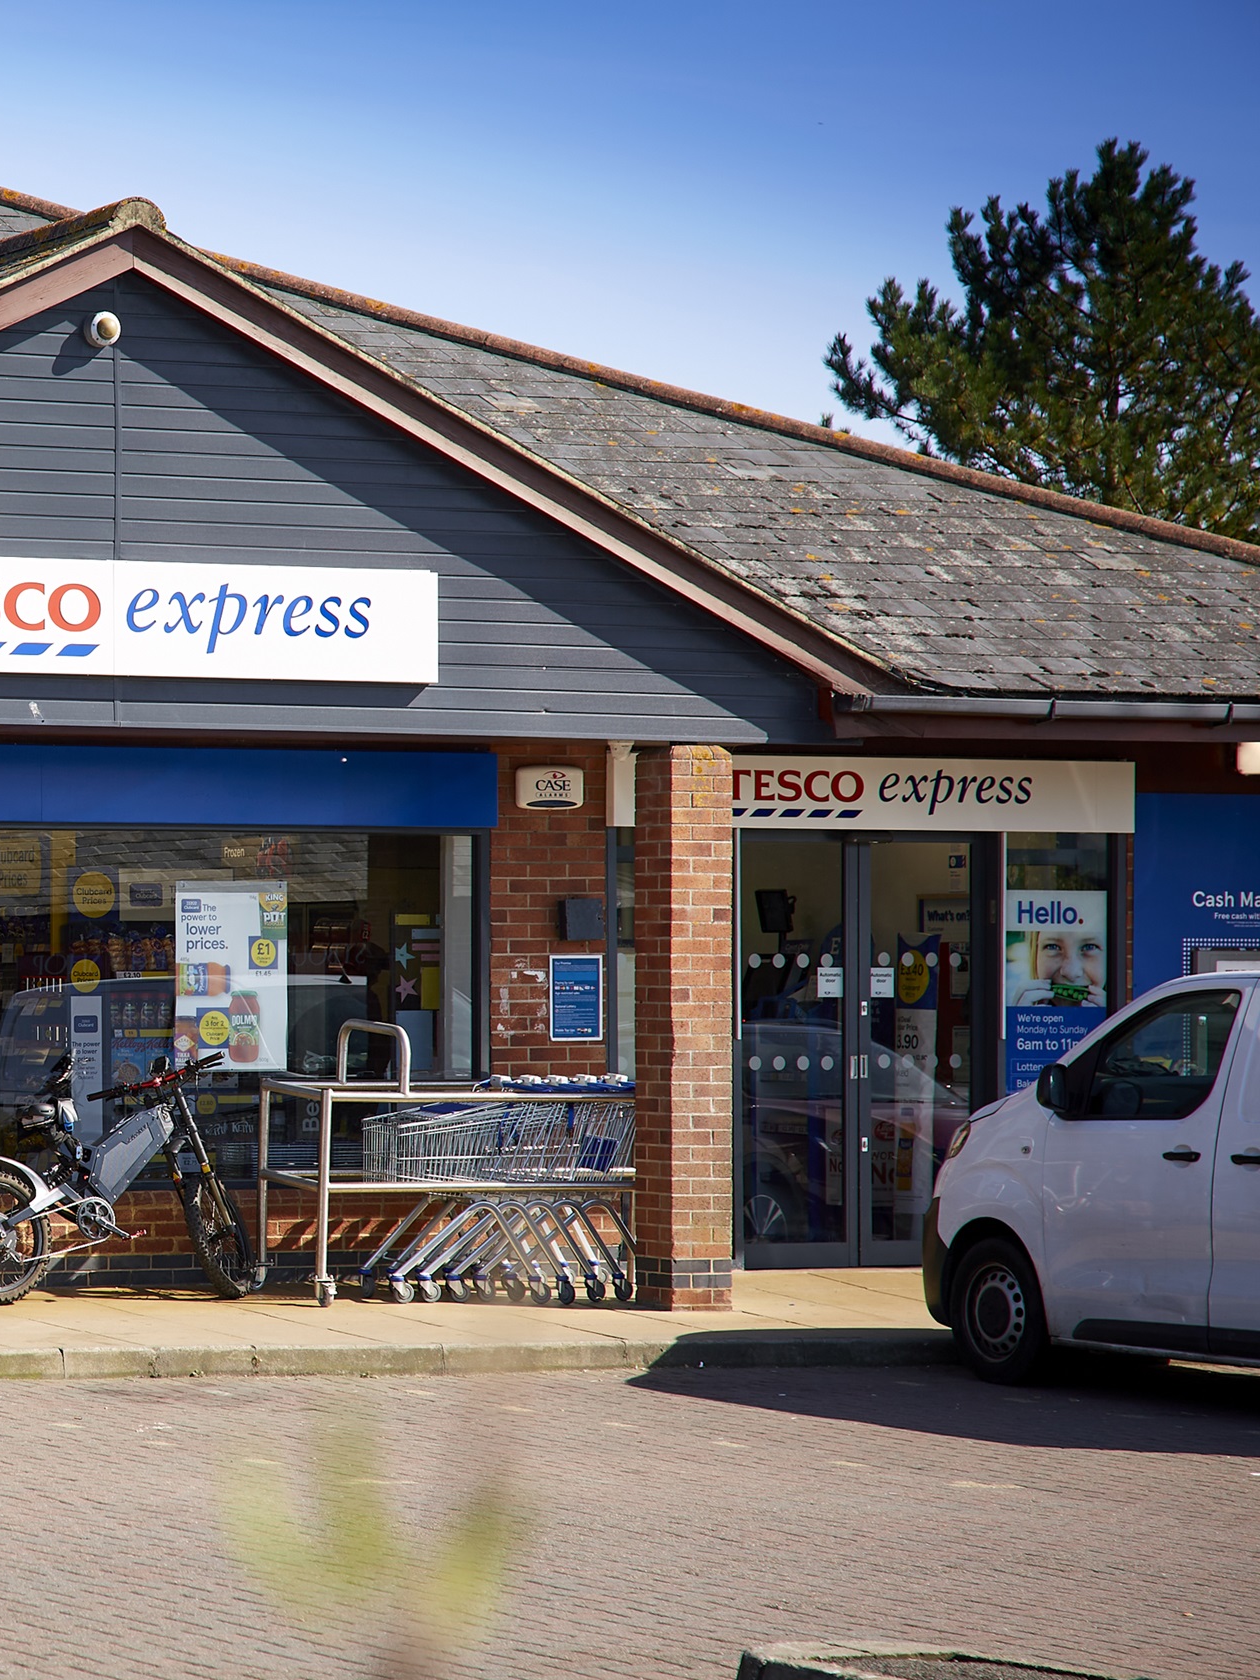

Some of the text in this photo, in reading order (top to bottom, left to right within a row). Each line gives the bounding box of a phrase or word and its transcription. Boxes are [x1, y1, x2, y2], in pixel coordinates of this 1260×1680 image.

[126, 583, 372, 654] express
[535, 779, 571, 791] CASE
[878, 769, 1033, 815] express
[223, 846, 246, 858] Frozen
[76, 887, 113, 896] Clubcard
[265, 893, 284, 902] KING
[82, 896, 107, 905] Prices
[1192, 890, 1235, 908] Cash
[202, 903, 217, 912] The
[1017, 901, 1084, 925] Hello.
[181, 913, 217, 923] power to
[927, 909, 954, 922] What's
[1214, 911, 1230, 920] Free
[1231, 912, 1248, 920] cash
[186, 922, 222, 936] lower
[186, 937, 229, 953] prices.
[257, 942, 270, 956] £1
[1017, 1014, 1064, 1024] We're open
[1017, 1026, 1088, 1036] Monday to Sunday
[1016, 1038, 1043, 1050] 6am
[1045, 1038, 1059, 1050] to
